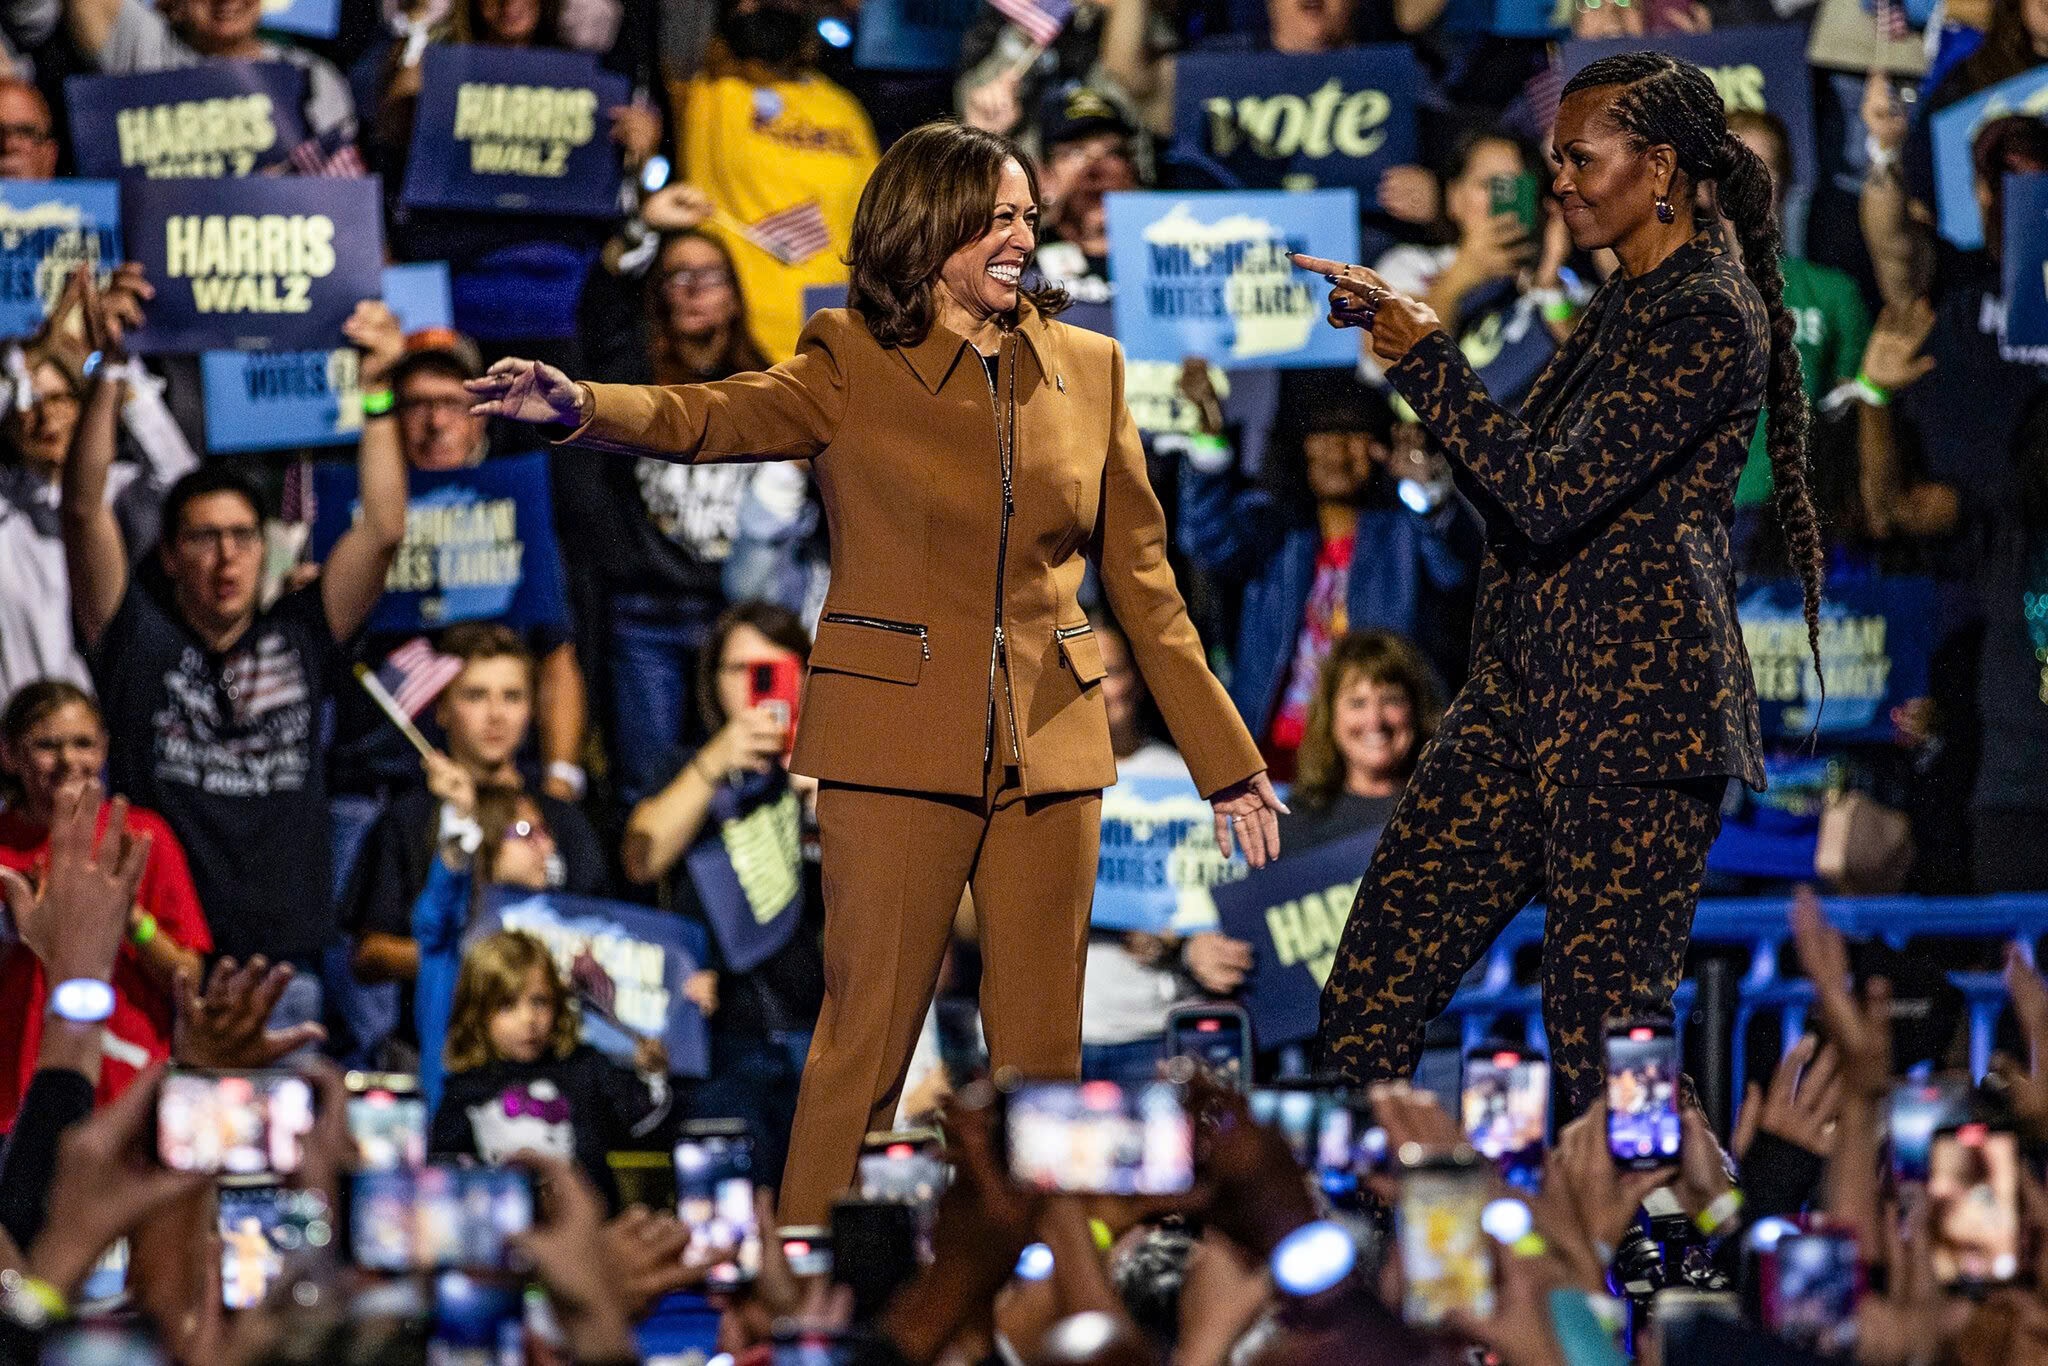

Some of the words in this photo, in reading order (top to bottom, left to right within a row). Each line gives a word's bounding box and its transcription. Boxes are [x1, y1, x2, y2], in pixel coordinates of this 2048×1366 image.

[117, 94, 276, 167] HARRIS
[454, 82, 599, 145] HARRIS
[1205, 77, 1391, 158] vote
[470, 141, 569, 178] WALZ
[166, 214, 336, 278] HARRIS
[191, 275, 312, 314] WALZ
